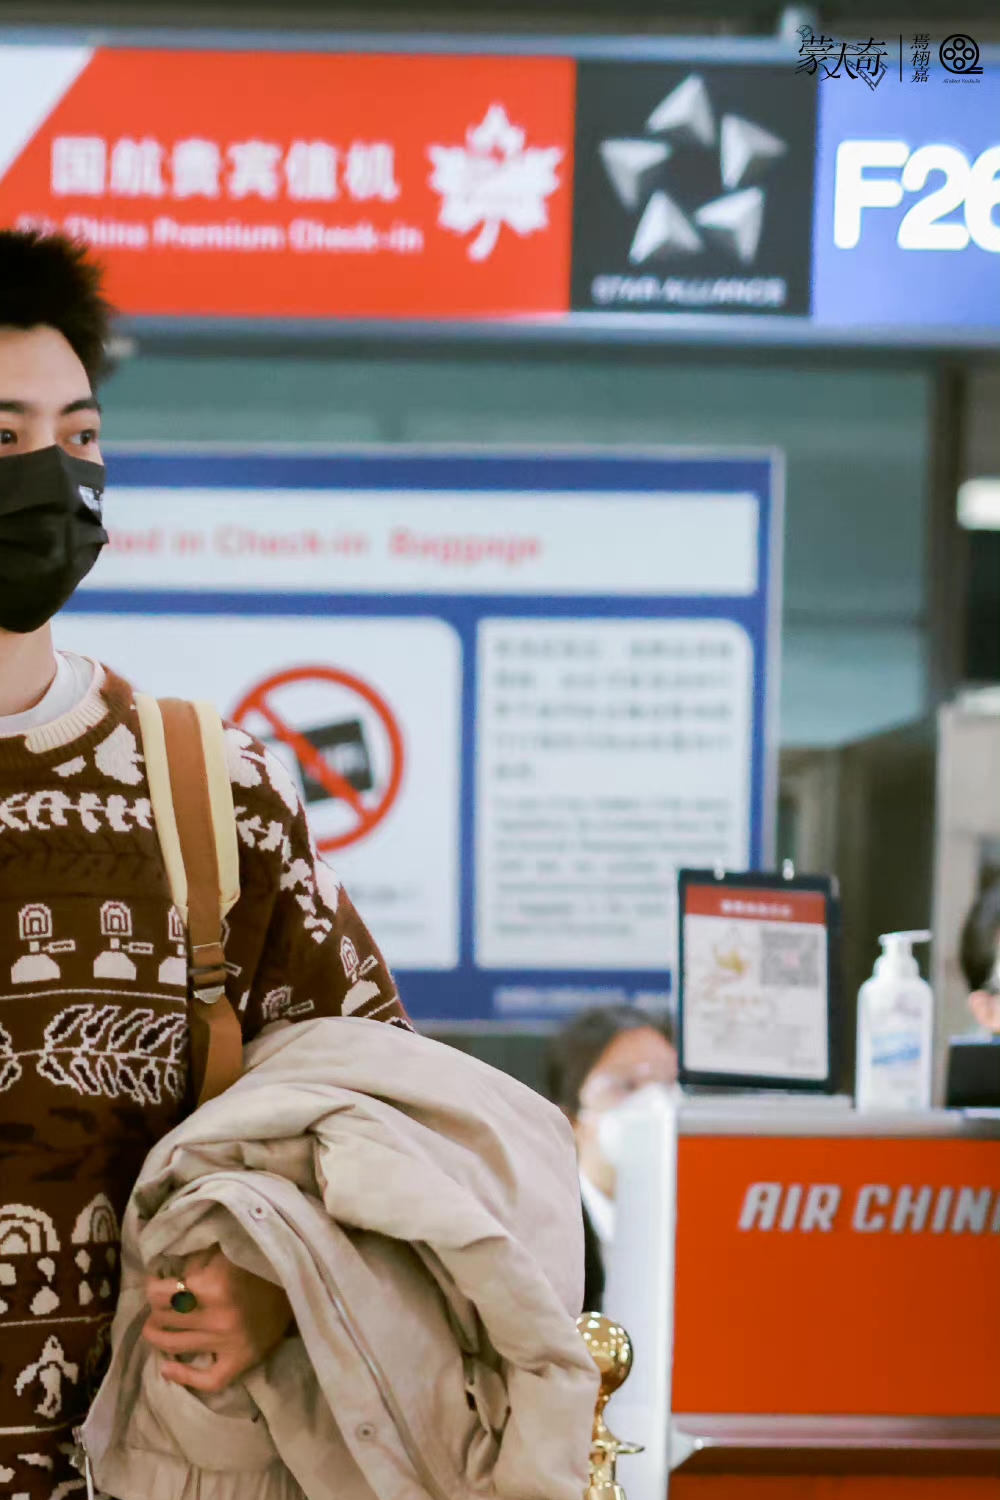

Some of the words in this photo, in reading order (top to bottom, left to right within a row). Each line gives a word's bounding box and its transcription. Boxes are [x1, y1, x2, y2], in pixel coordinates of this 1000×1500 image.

[834, 139, 1000, 253] F26
[737, 1181, 842, 1233] AIR
[853, 1183, 1000, 1235] CHIN
